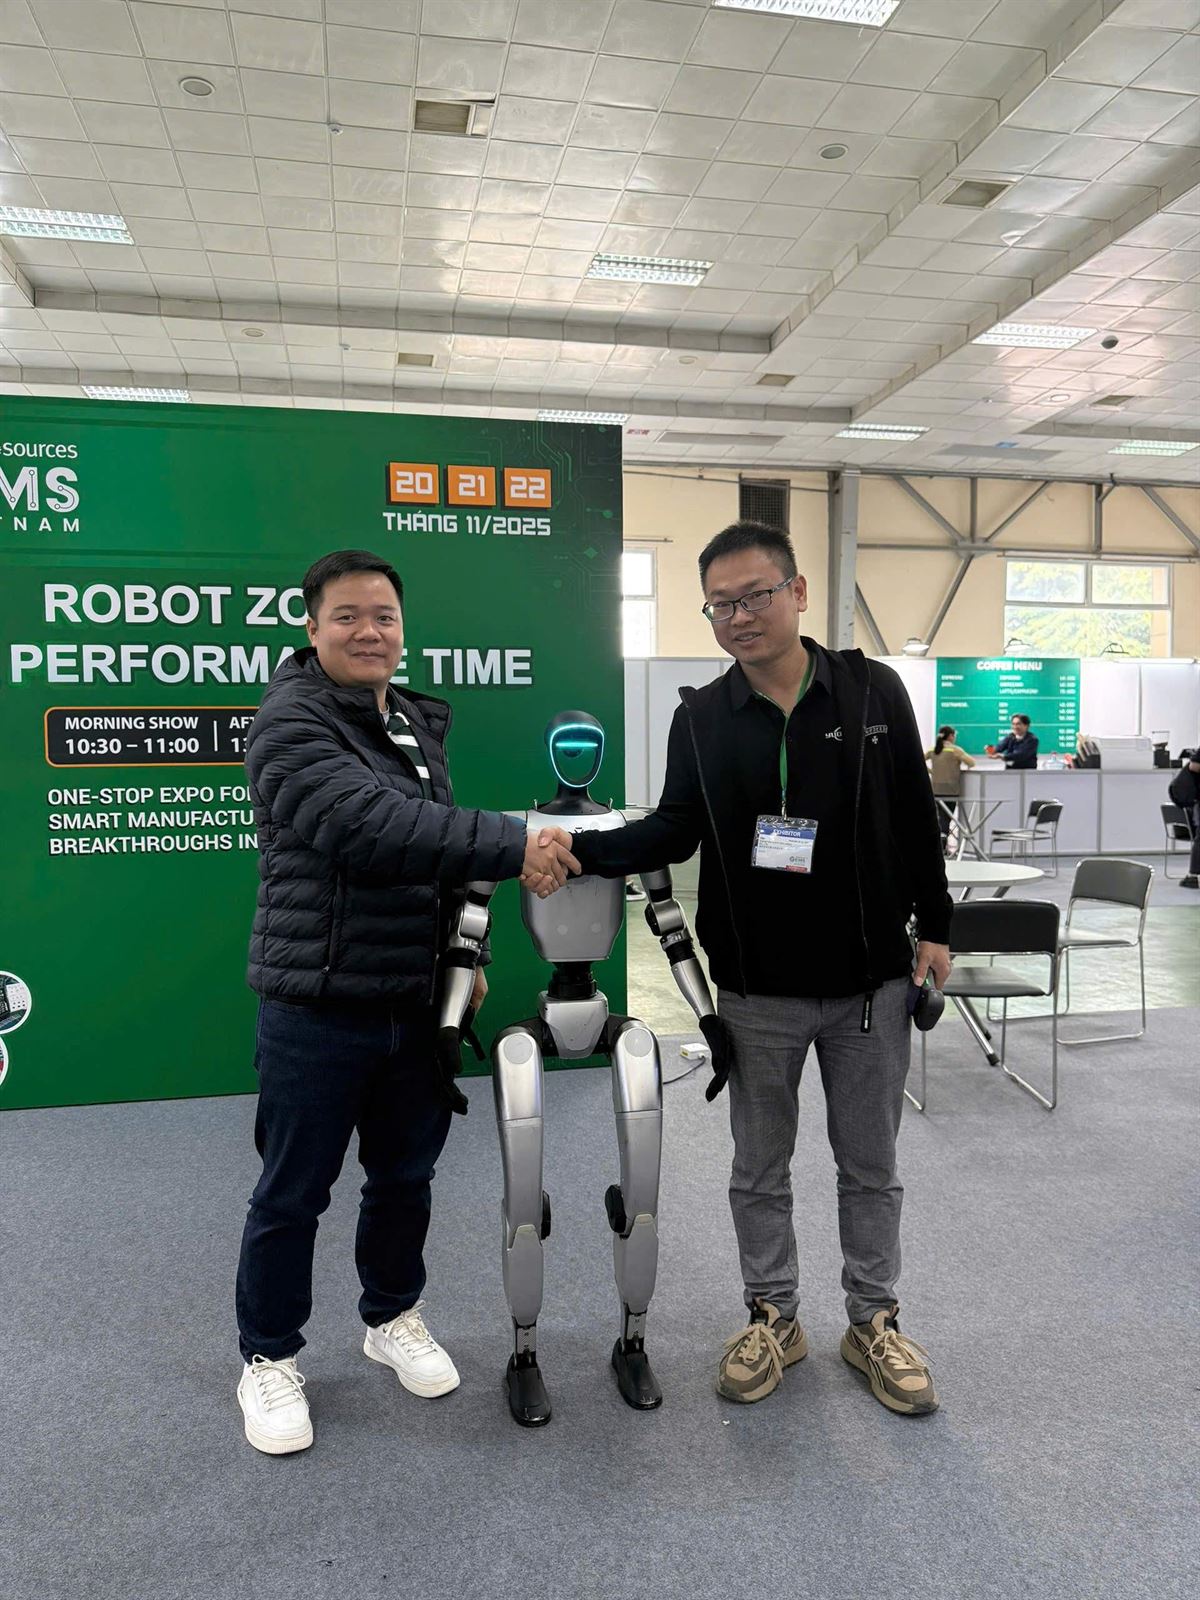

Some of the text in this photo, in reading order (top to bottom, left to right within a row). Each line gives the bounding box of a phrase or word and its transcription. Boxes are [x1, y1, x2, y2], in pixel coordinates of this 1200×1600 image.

[3, 442, 78, 459] sources
[397, 472, 545, 498] 20 21 22
[0, 517, 79, 531] NAM
[383, 511, 550, 535] THÁNG 11/2025
[45, 584, 231, 623] ROBOT
[423, 649, 531, 684] TIME
[1014, 661, 1043, 671] MENU
[66, 717, 198, 729] MORNING SHOW
[66, 739, 121, 754] 10:30
[144, 738, 199, 753] 11:00
[48, 785, 252, 804] ONE-STOP EXPO FO
[50, 810, 254, 829] SMART MANUFACTU
[51, 835, 232, 854] BREAKTHROUGHS
